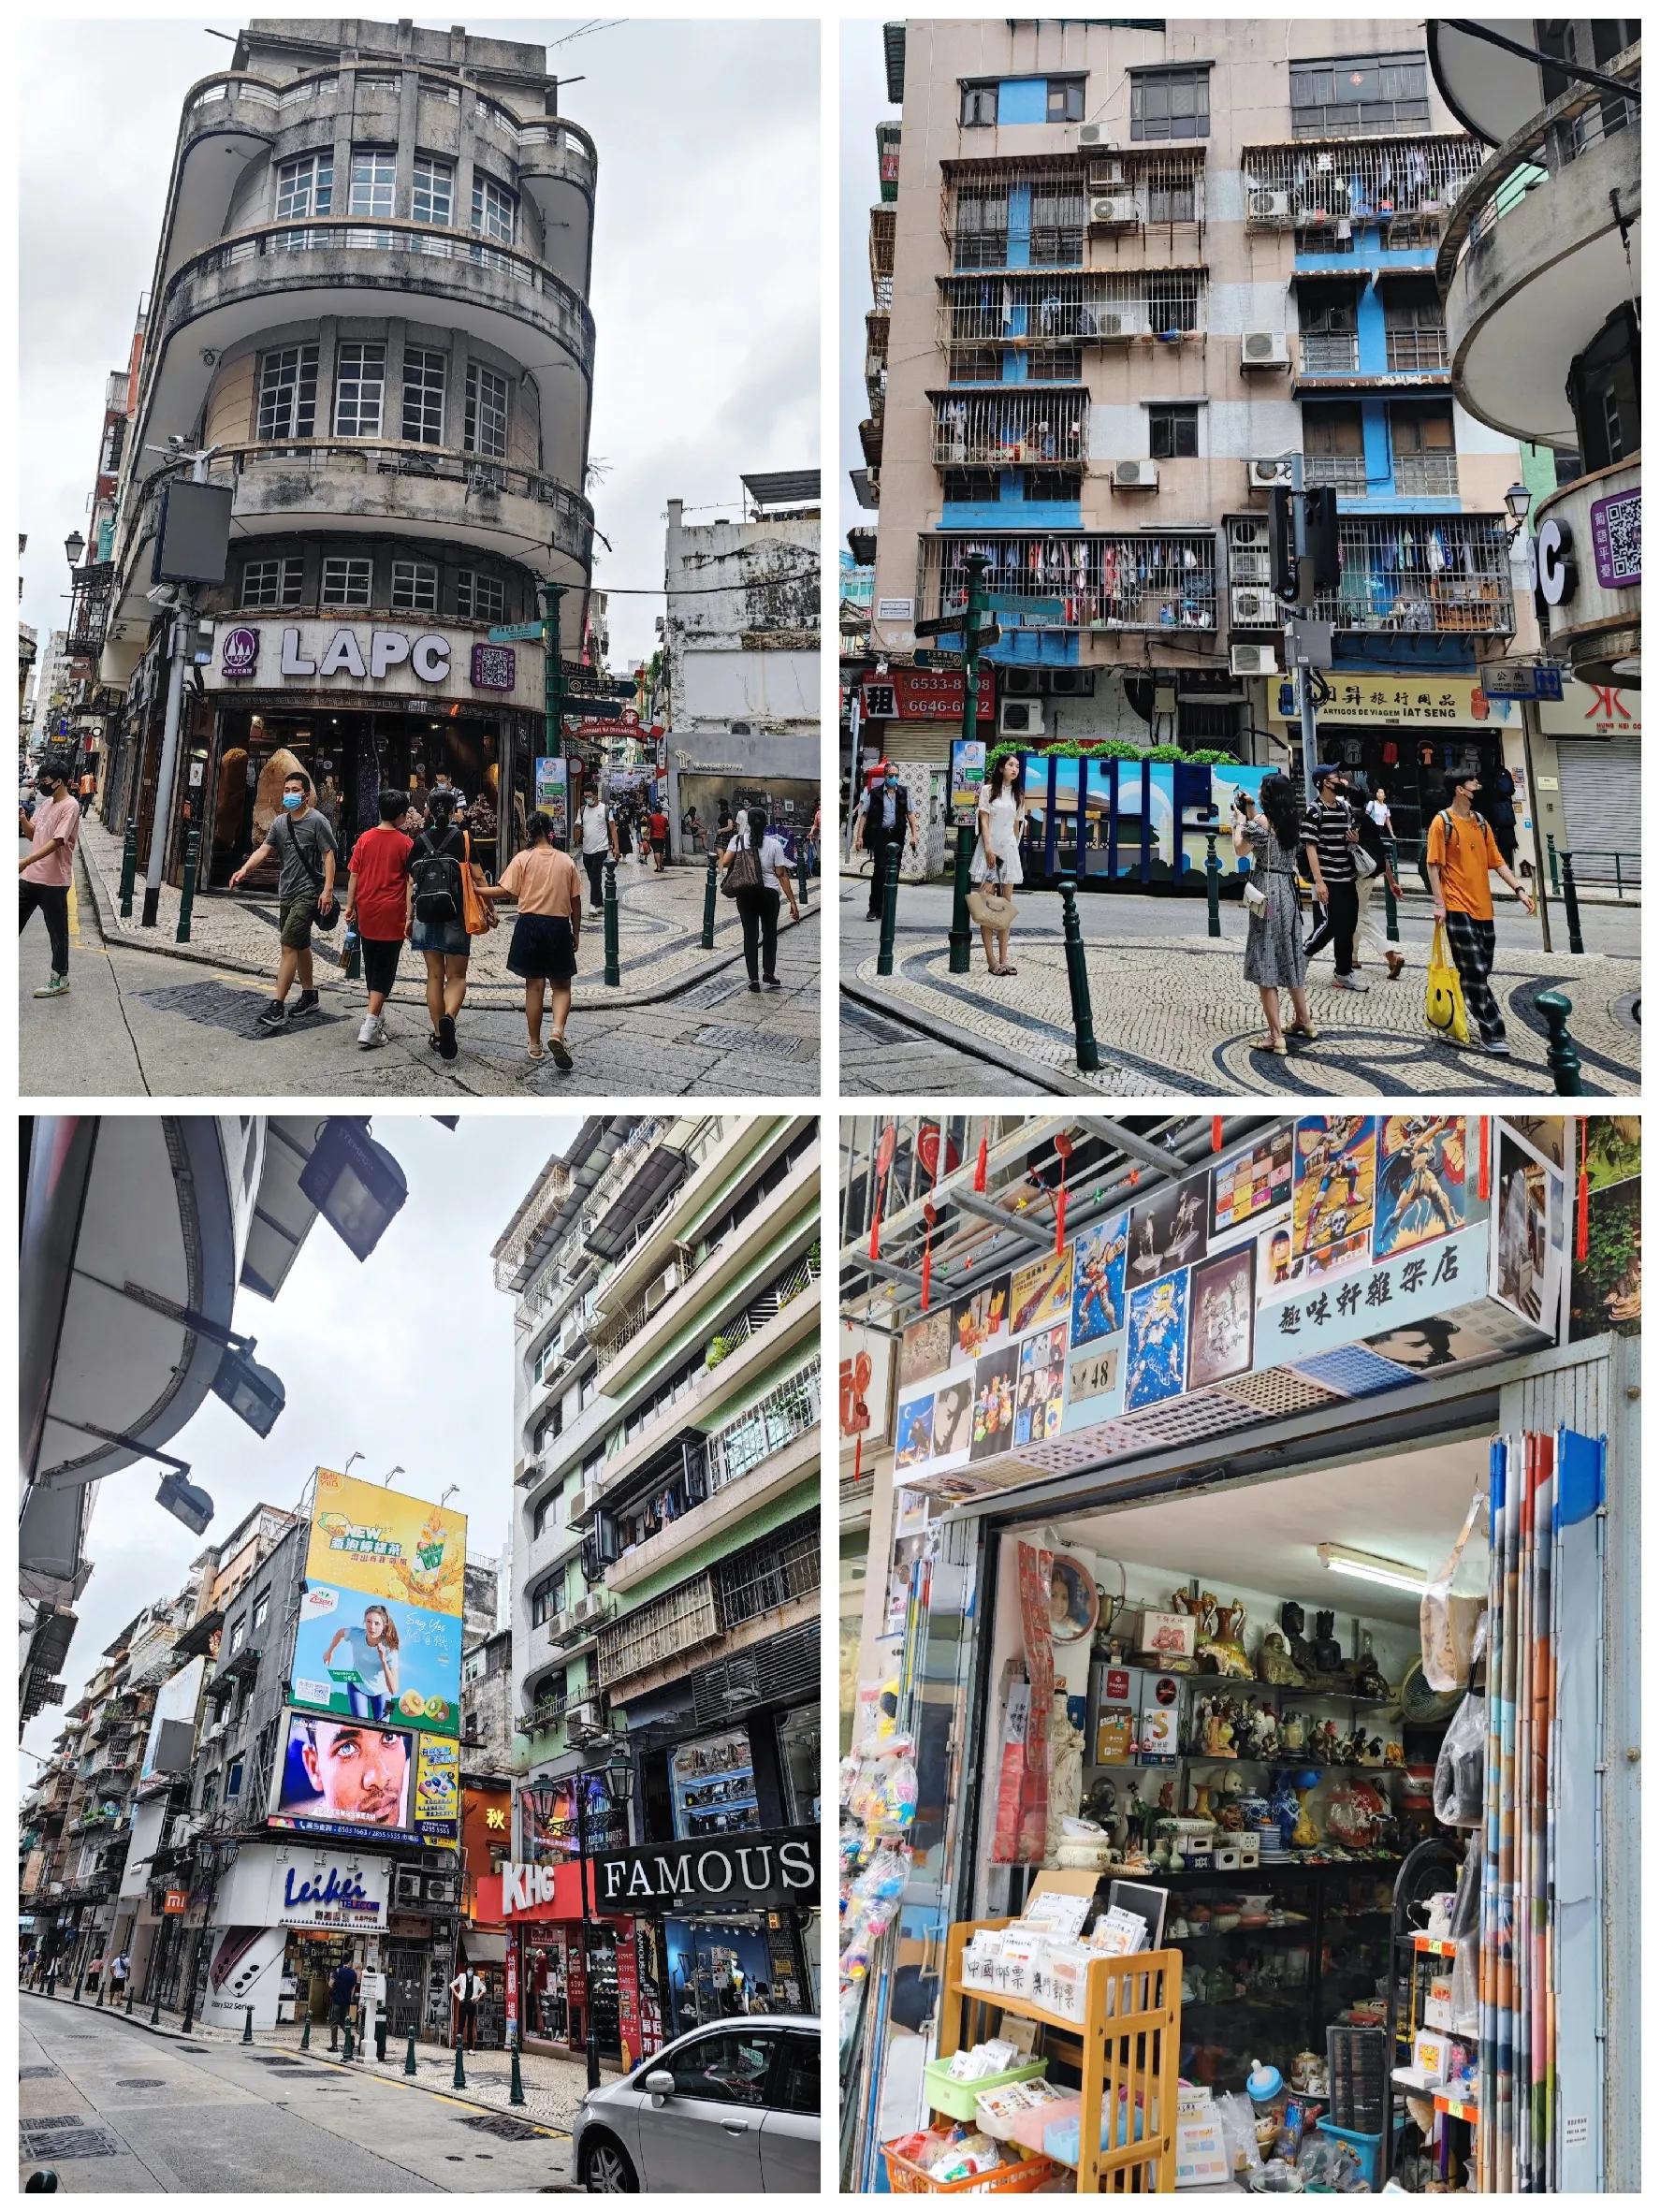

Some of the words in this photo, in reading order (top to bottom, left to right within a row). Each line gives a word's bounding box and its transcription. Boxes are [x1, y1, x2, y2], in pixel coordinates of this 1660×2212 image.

[281, 628, 452, 682] LAPC
[866, 685, 894, 715] 租
[1323, 707, 1357, 716] ARTIGOS
[1370, 708, 1400, 717] VIAGEM
[1403, 707, 1421, 717] IAT
[1424, 708, 1456, 718] SENG
[1091, 1361, 1109, 1389] 48
[345, 1524, 383, 1539] NEW
[487, 1808, 505, 1830] 秋
[604, 1841, 815, 1898] FAMOUS
[502, 1860, 555, 1915] KHG
